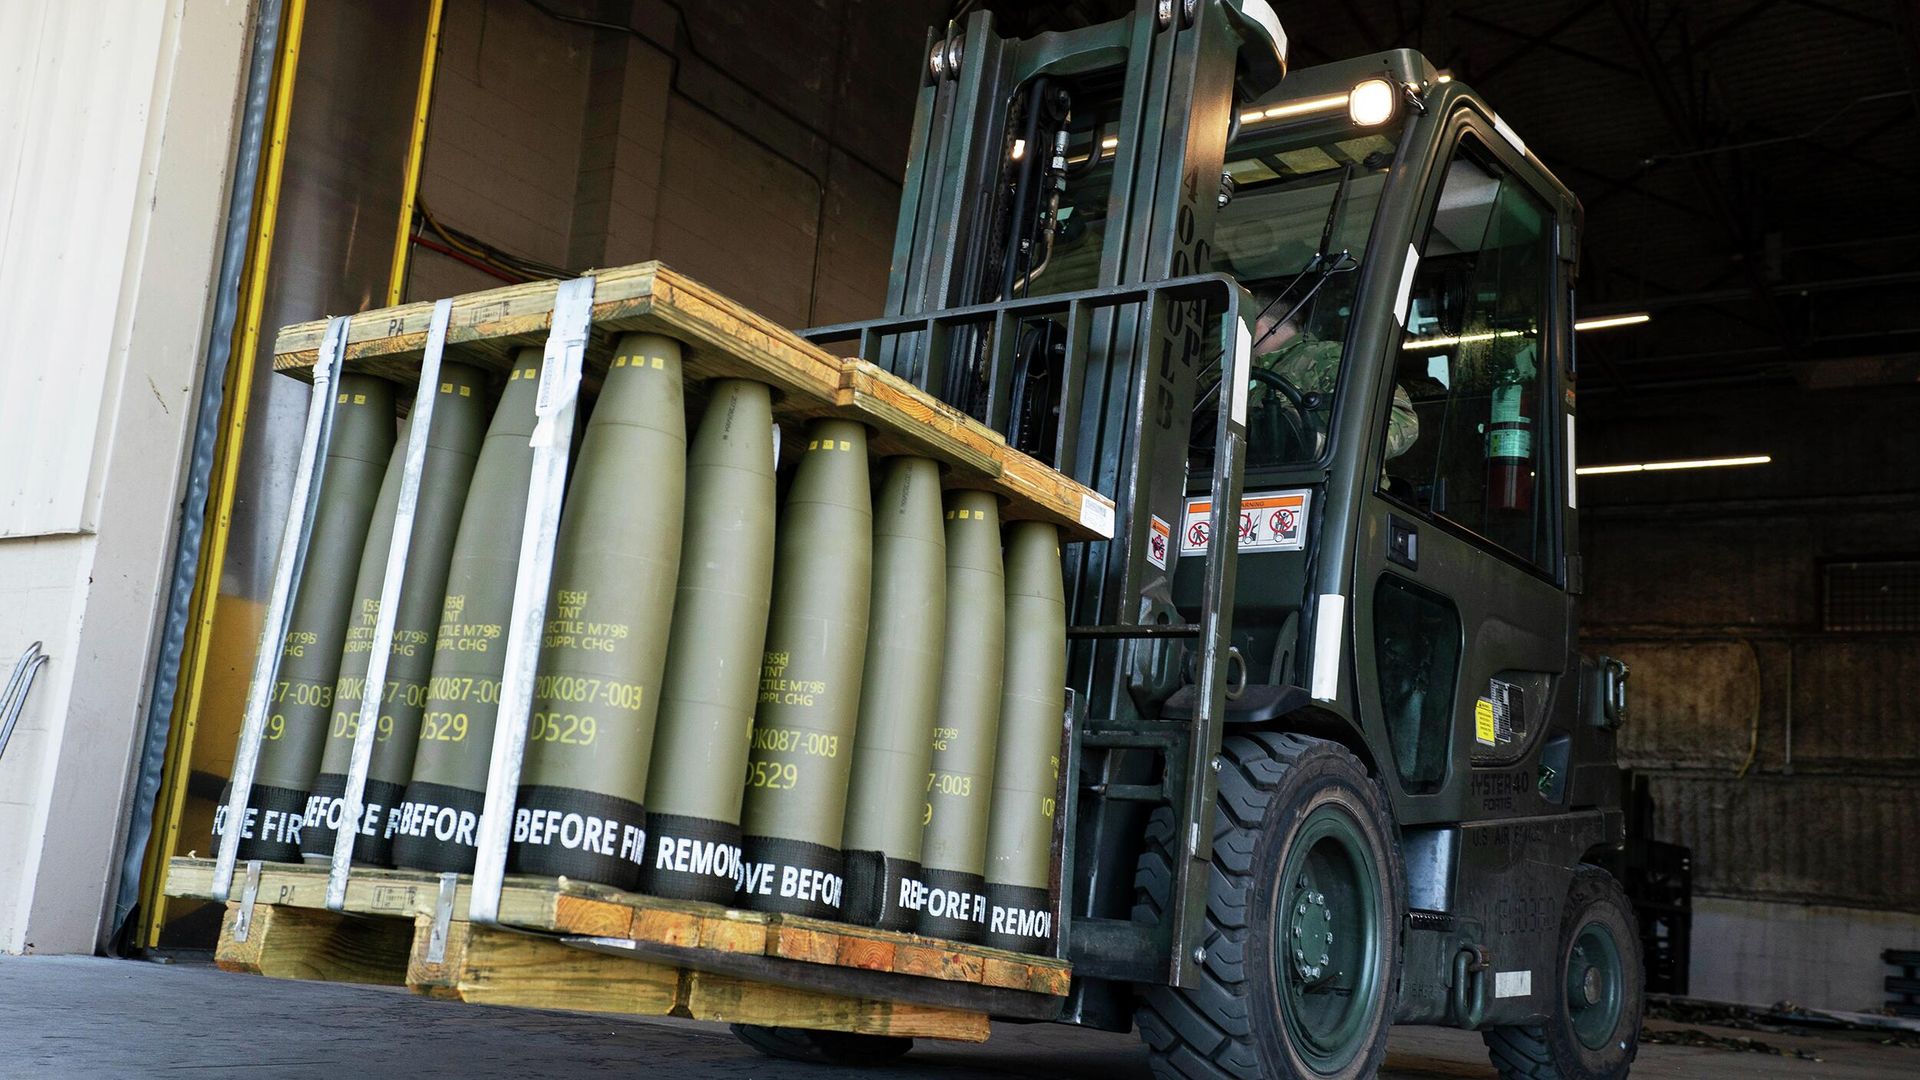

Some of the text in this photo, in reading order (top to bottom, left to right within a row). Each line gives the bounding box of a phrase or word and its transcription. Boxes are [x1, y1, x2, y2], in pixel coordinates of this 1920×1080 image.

[559, 606, 582, 618] TNT
[457, 638, 489, 652] CHG
[581, 636, 616, 652] CHG
[784, 692, 814, 707] CHG
[530, 712, 598, 747] D529
[513, 808, 619, 856] BEFORE
